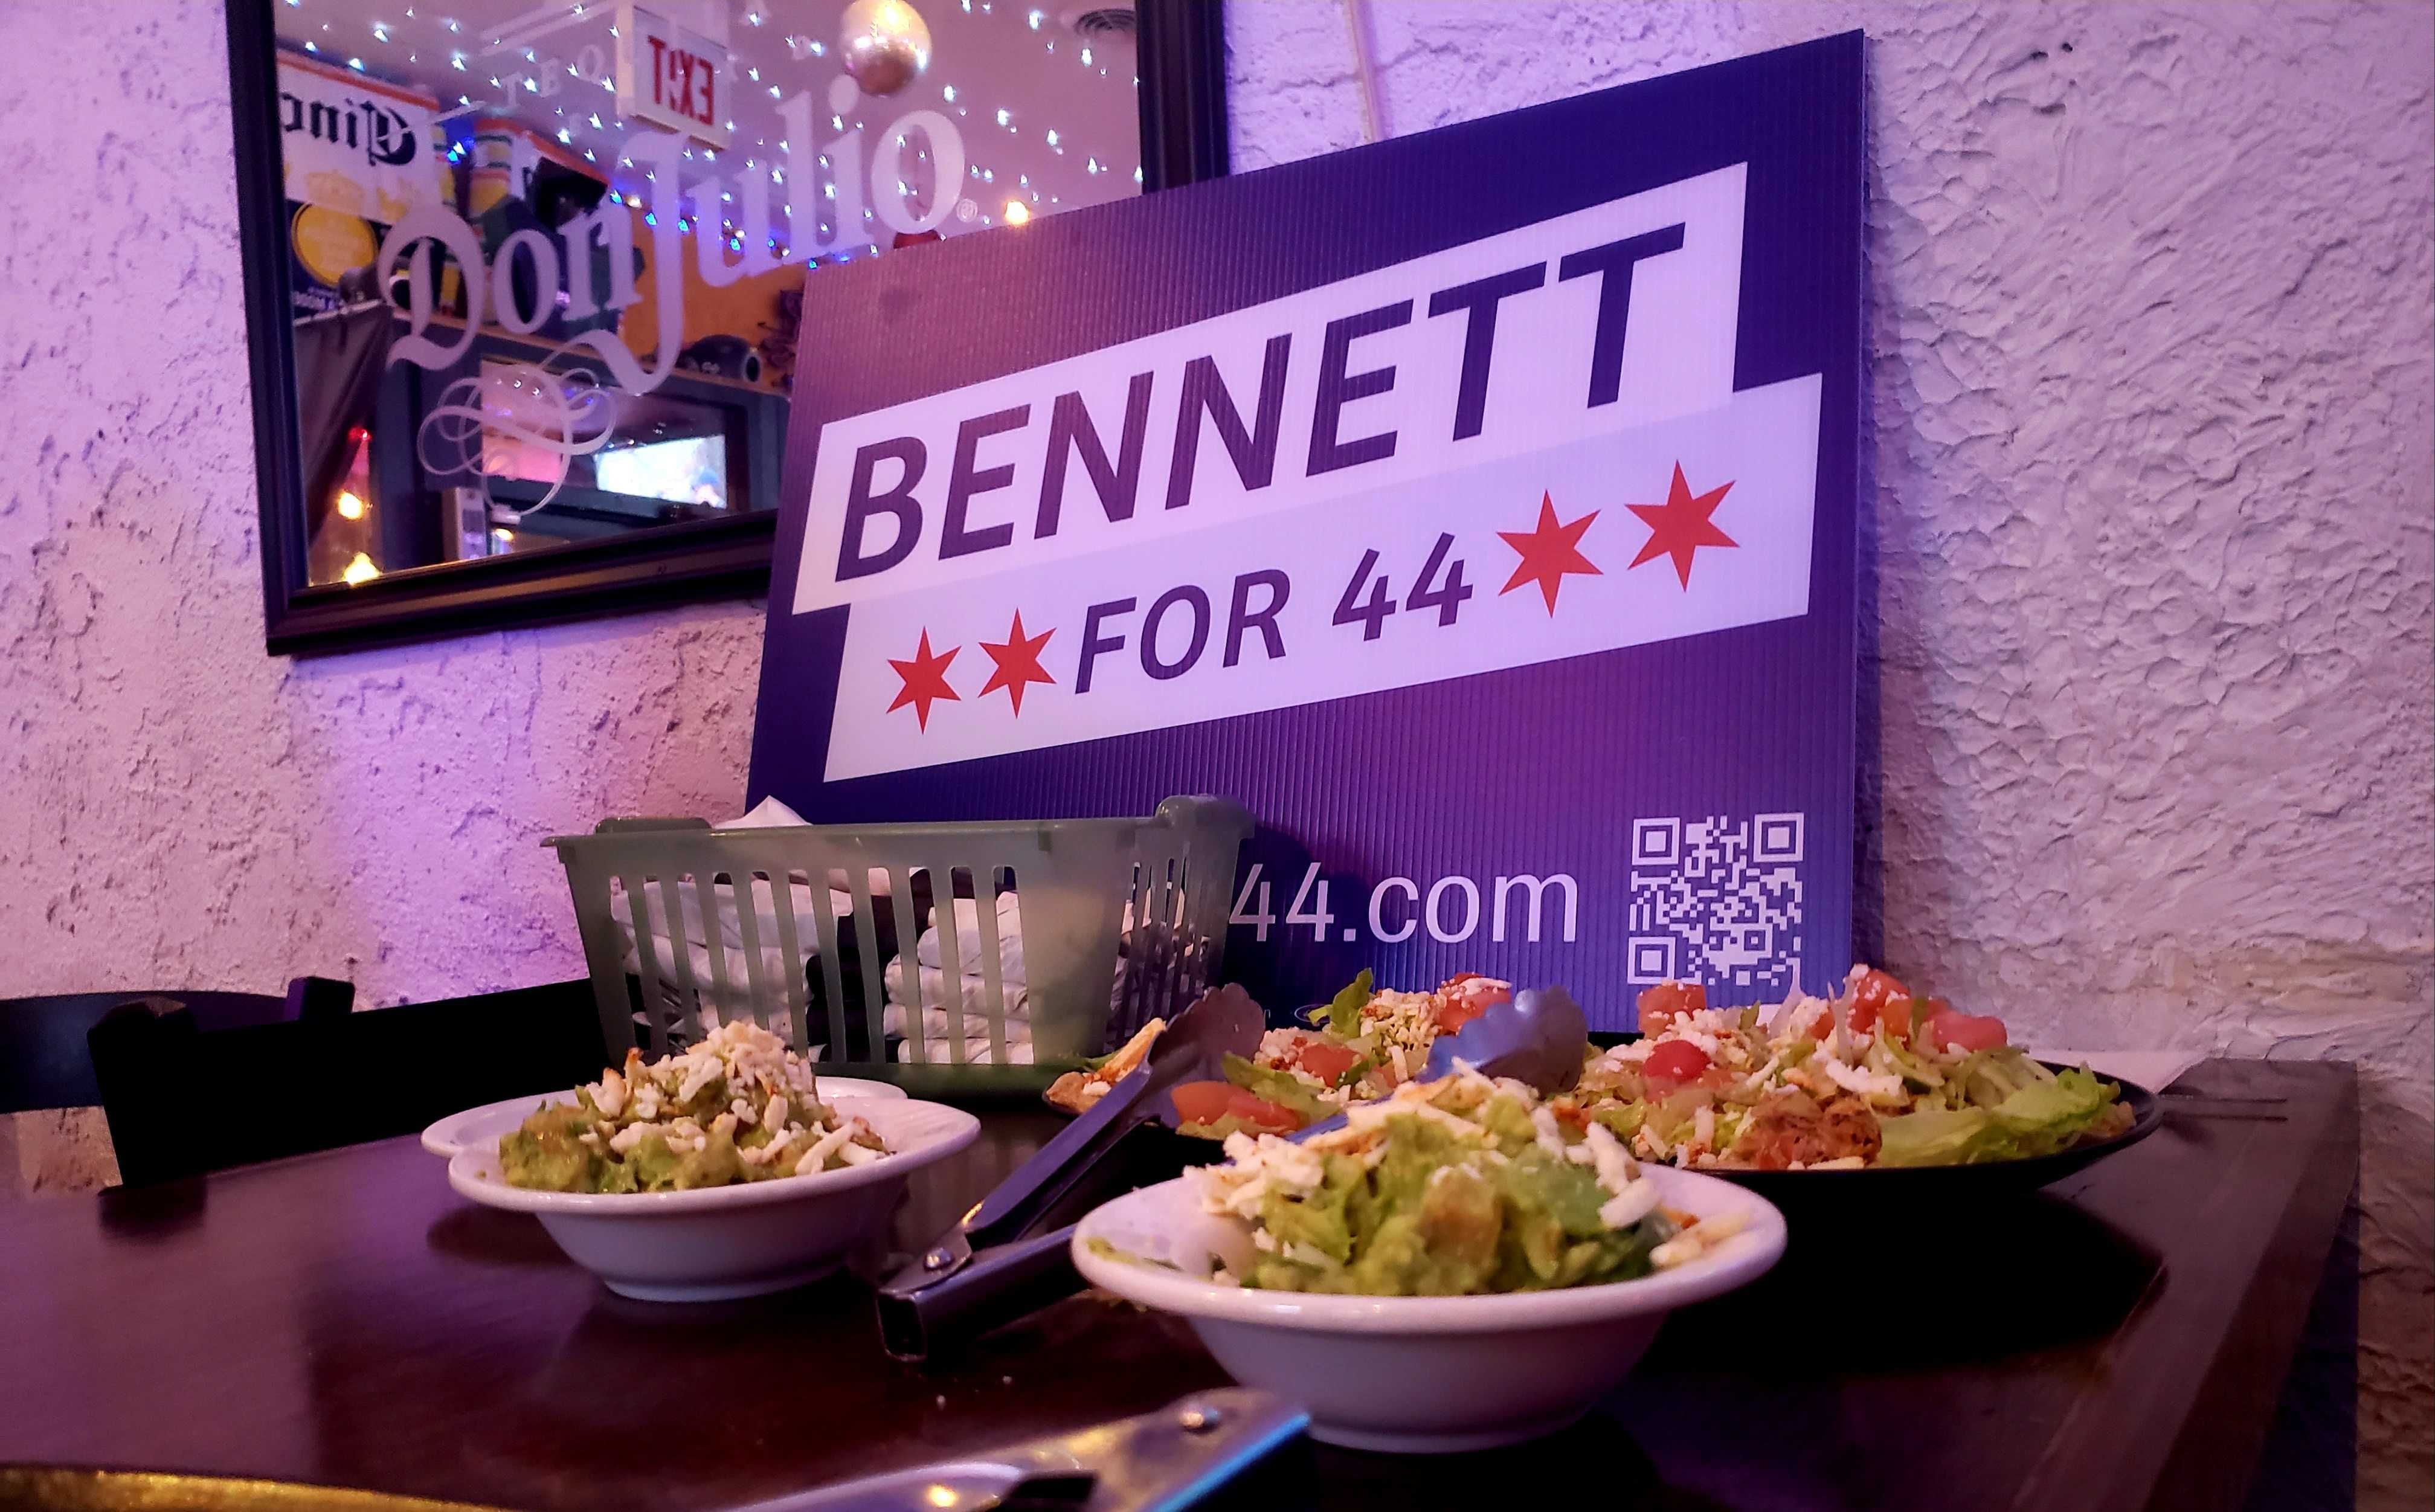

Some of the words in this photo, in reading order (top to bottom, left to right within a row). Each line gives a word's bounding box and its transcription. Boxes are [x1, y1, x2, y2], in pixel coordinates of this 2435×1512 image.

[378, 195, 644, 371] Don
[835, 222, 1686, 584] BENNETT
[1075, 568, 1290, 695] FOR
[1332, 532, 1474, 642] 44
[1229, 861, 1578, 943] 44.com
